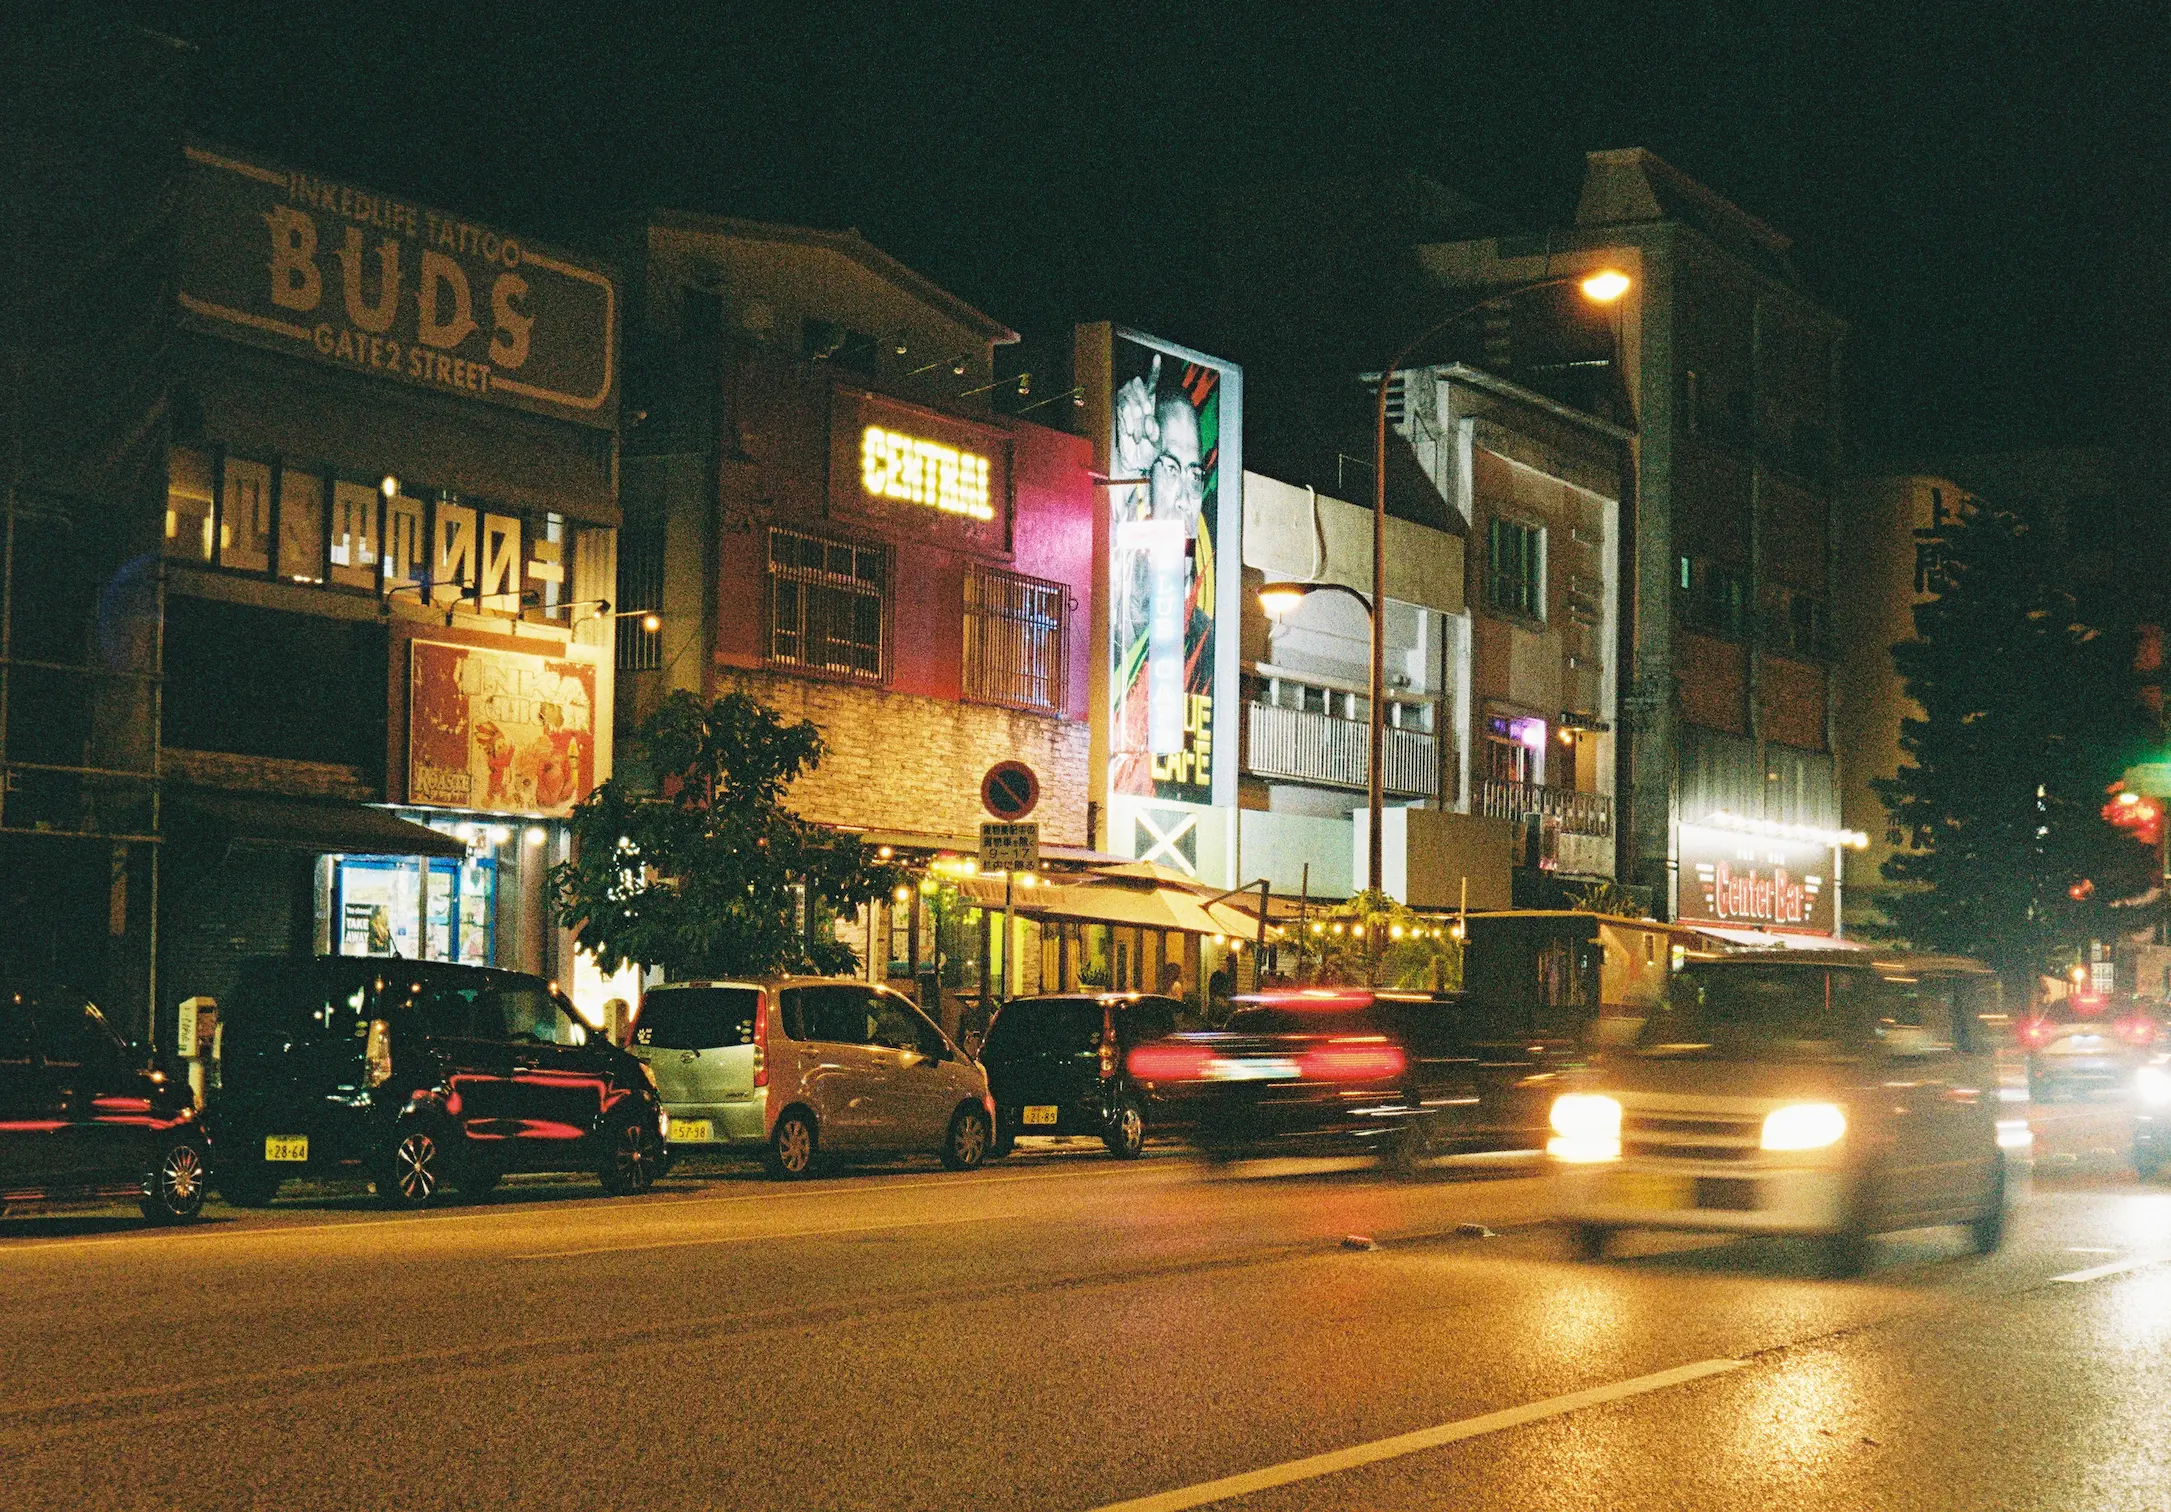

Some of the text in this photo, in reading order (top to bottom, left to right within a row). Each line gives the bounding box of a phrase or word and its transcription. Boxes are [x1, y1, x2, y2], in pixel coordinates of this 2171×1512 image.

[424, 207, 521, 269] TATTOO
[260, 204, 535, 369] BUDS
[408, 346, 493, 394] STREET
[1716, 859, 1805, 923] Center Bar
